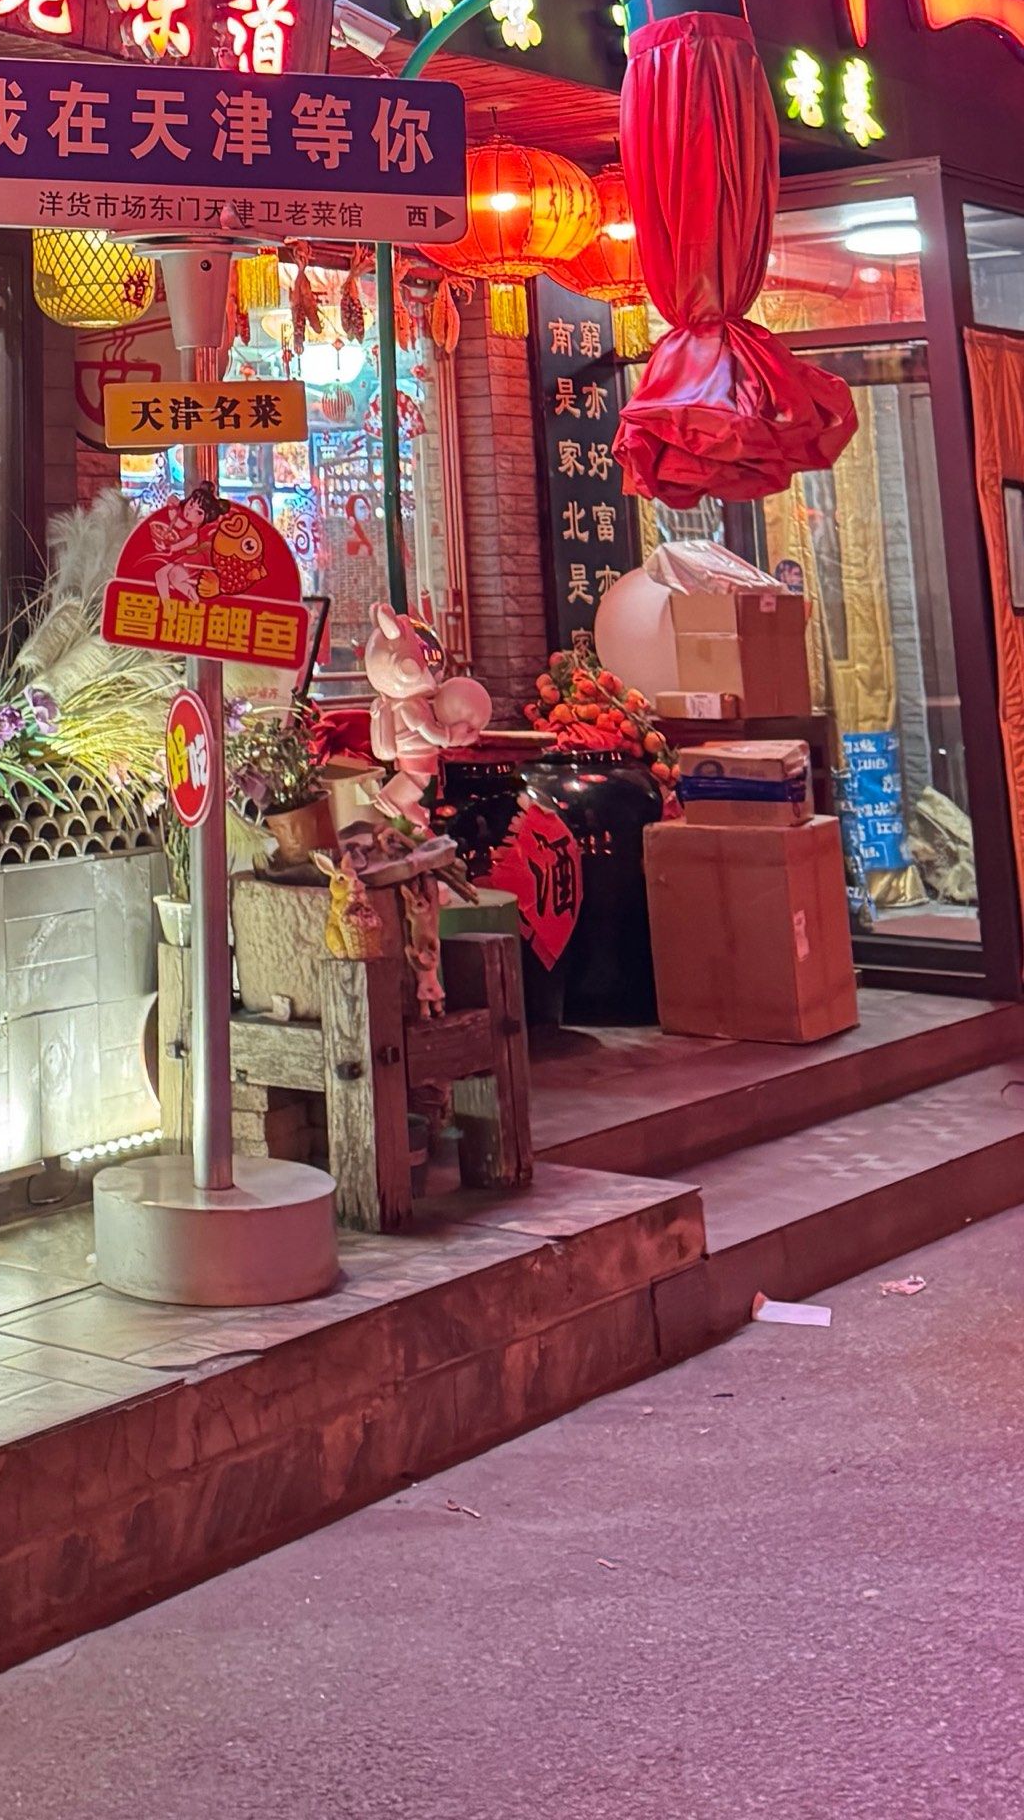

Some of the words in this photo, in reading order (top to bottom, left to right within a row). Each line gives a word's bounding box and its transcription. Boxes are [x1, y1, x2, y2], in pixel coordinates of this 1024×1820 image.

[38, 188, 365, 230] 洋货市场东门天津卫老菜馆
[406, 204, 428, 228] 西
[130, 394, 283, 432] 天津名菜
[528, 829, 576, 918] 酒
